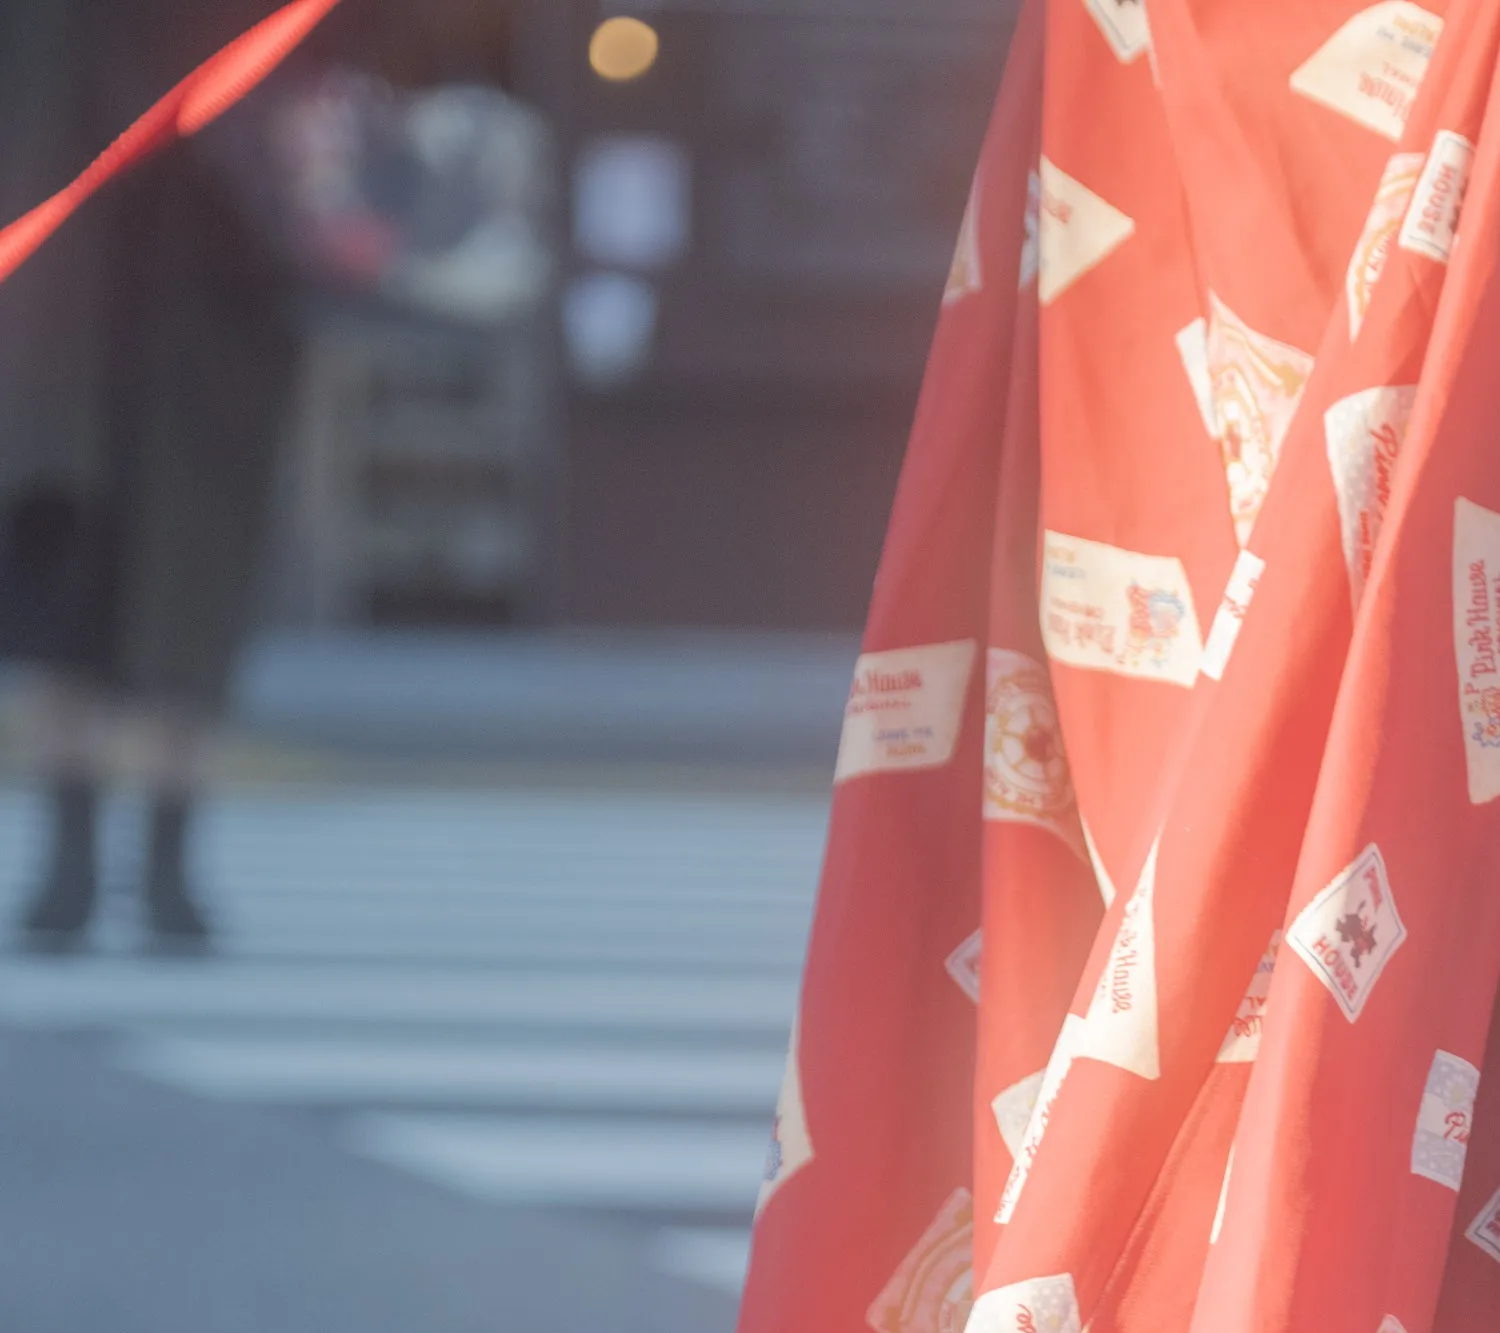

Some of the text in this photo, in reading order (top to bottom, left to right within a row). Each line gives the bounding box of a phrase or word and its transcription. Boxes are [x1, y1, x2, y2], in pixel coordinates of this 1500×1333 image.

[1418, 163, 1457, 235] HOUSE
[1466, 558, 1497, 679] Pink House
